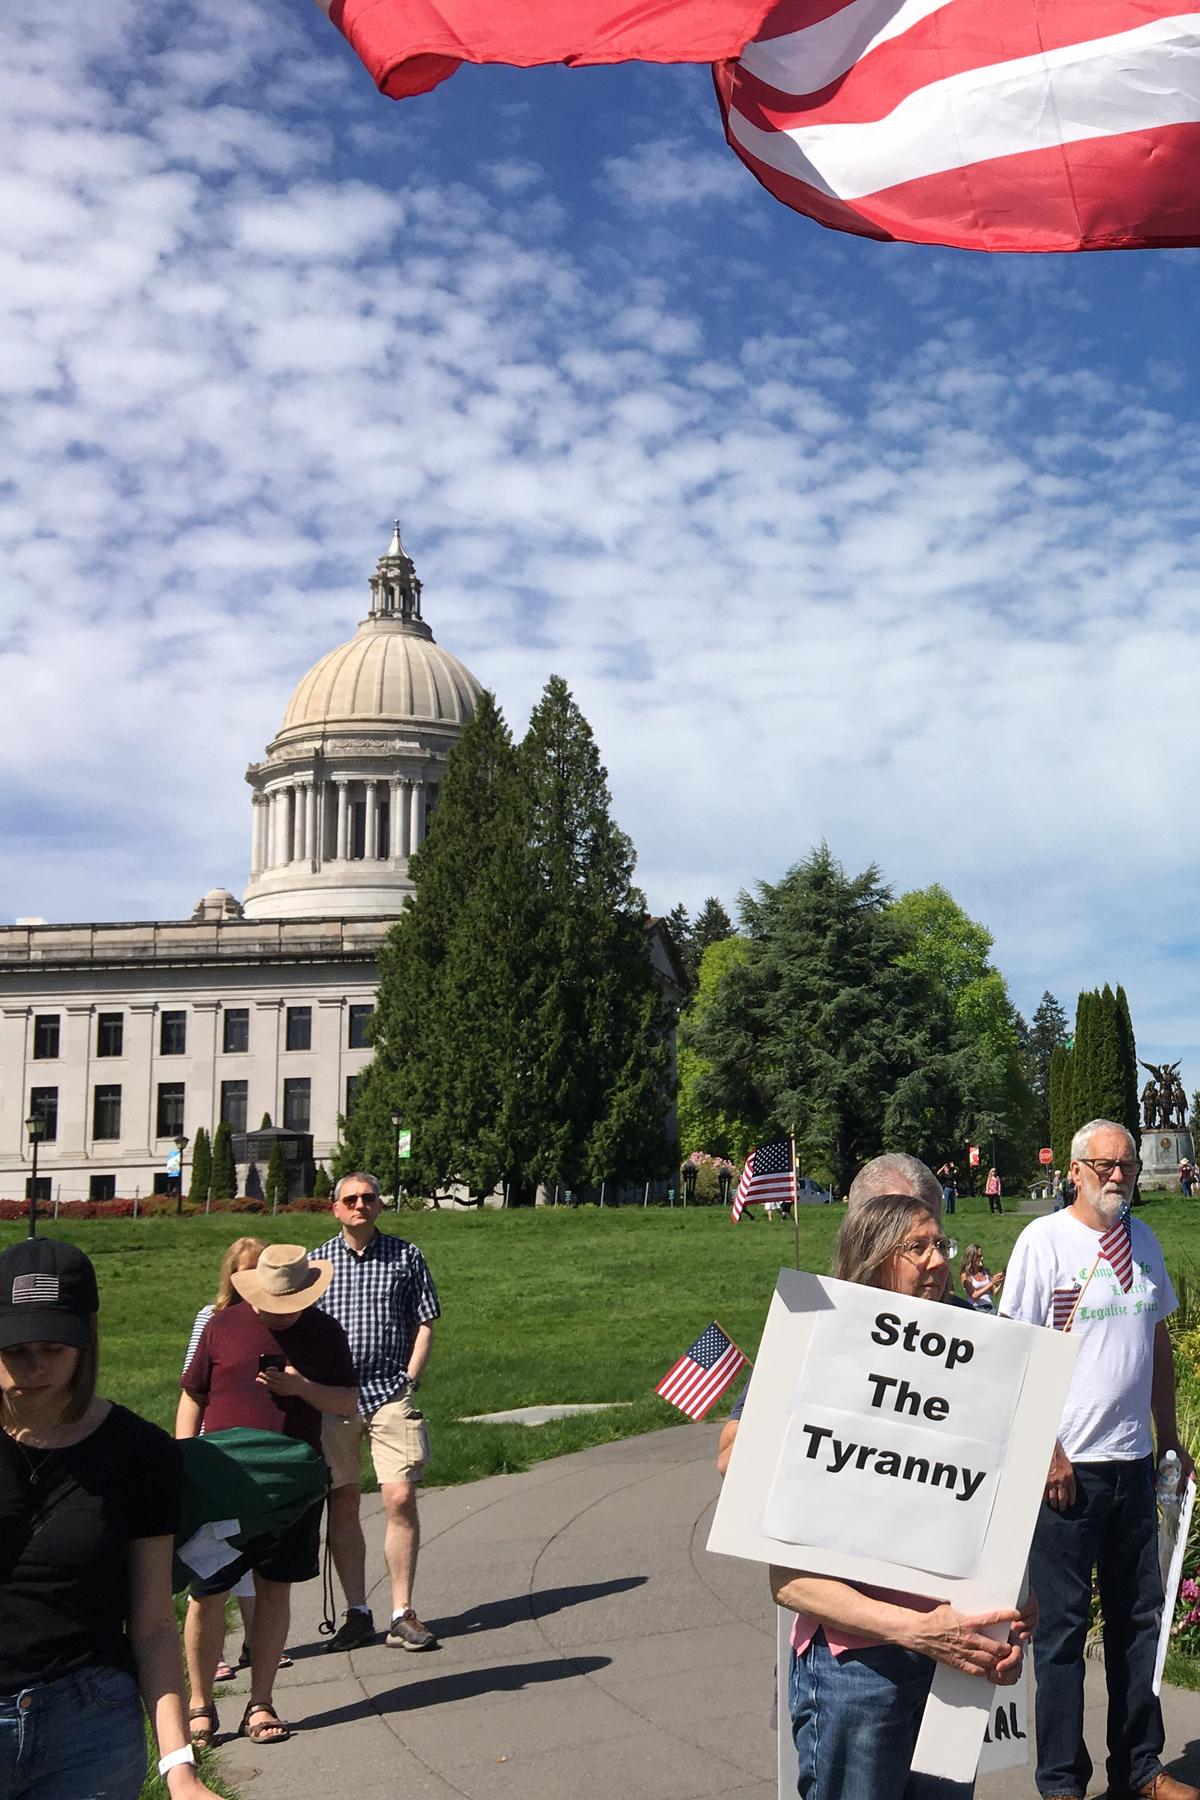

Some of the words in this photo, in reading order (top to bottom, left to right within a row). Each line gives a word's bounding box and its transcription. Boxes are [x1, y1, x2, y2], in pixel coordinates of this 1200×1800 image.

[1079, 1304, 1129, 1320] Legalize
[871, 1312, 974, 1369] Stop
[868, 1373, 950, 1421] The
[803, 1425, 987, 1501] Tyranny
